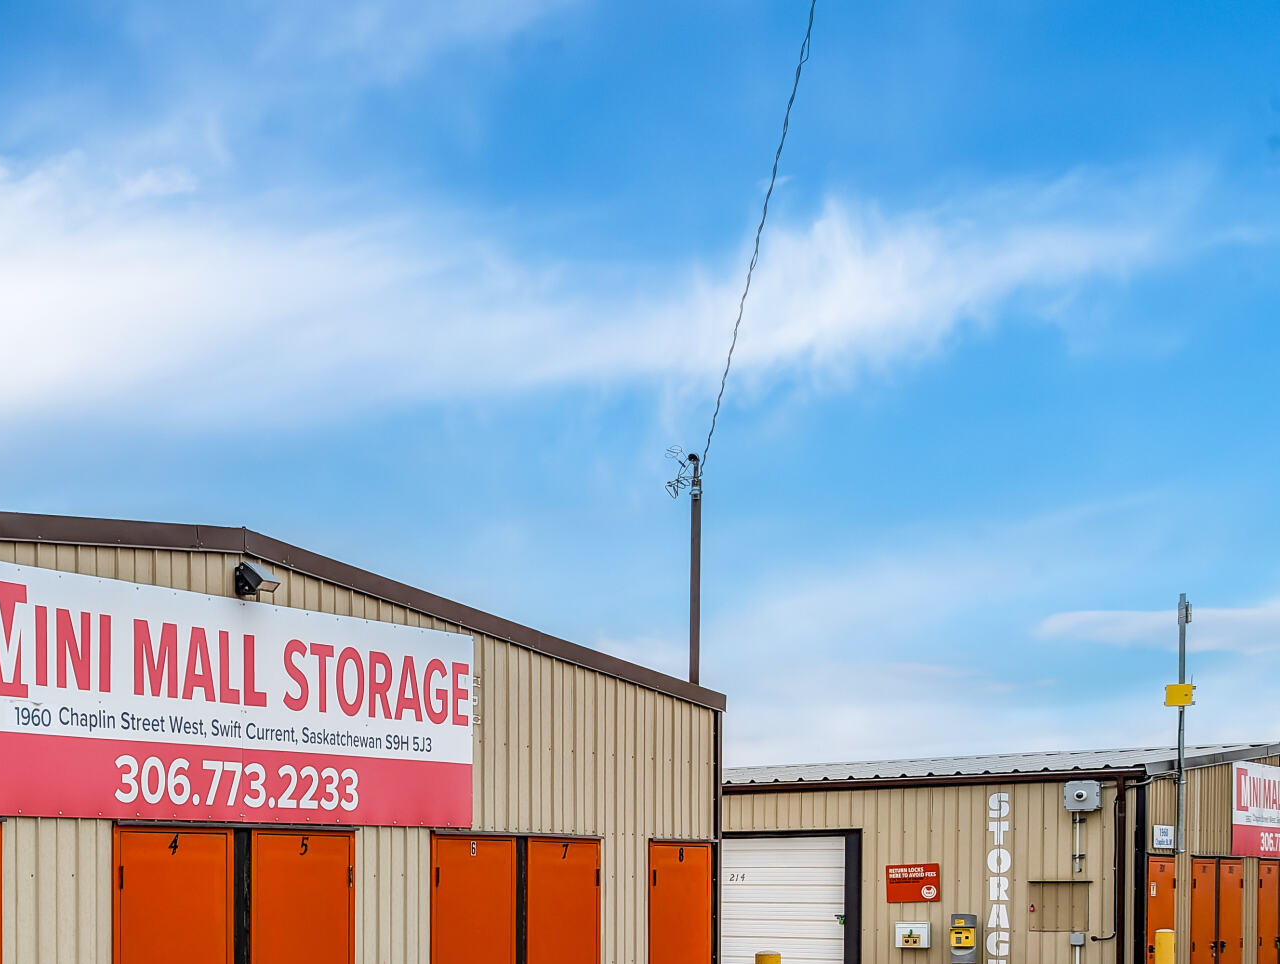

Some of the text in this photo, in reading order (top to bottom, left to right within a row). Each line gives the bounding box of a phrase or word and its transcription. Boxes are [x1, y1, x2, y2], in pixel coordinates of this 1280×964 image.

[133, 619, 267, 707] MALL
[283, 639, 470, 726] STORAGE
[14, 706, 432, 753] 1960 Chaplin Street West, Swift Current, Saskatchewan S9H 5J3
[114, 755, 359, 811] 306.773.2233
[168, 833, 179, 856] 4
[299, 836, 310, 856] 5
[561, 843, 570, 860] 7
[1260, 831, 1280, 852] 306.7
[678, 847, 685, 862] 8
[729, 873, 746, 882] 214
